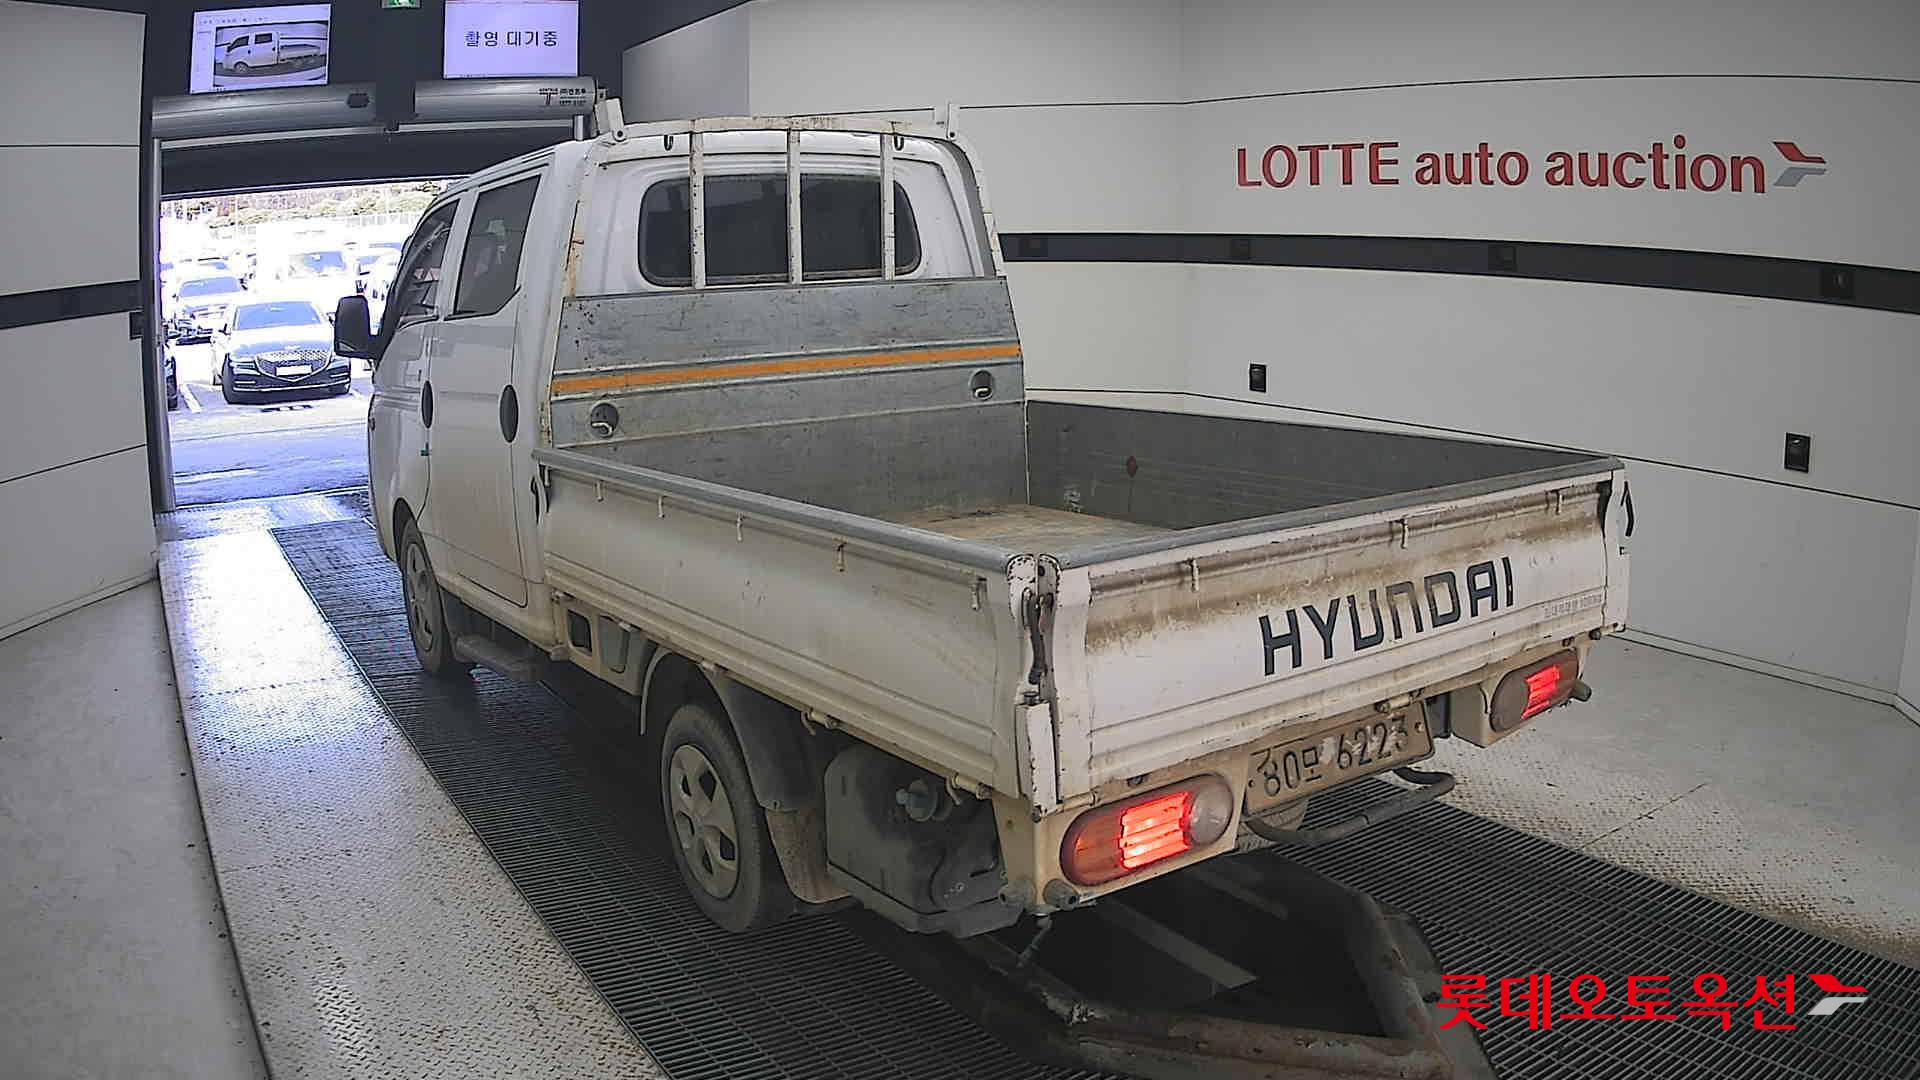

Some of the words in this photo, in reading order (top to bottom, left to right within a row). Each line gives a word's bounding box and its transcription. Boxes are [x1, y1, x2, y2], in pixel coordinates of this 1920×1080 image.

[1236, 141, 1400, 188] LOTTE
[1415, 142, 1528, 186] auto
[1545, 135, 1766, 194] auction
[1258, 556, 1514, 677] HYUNDAI
